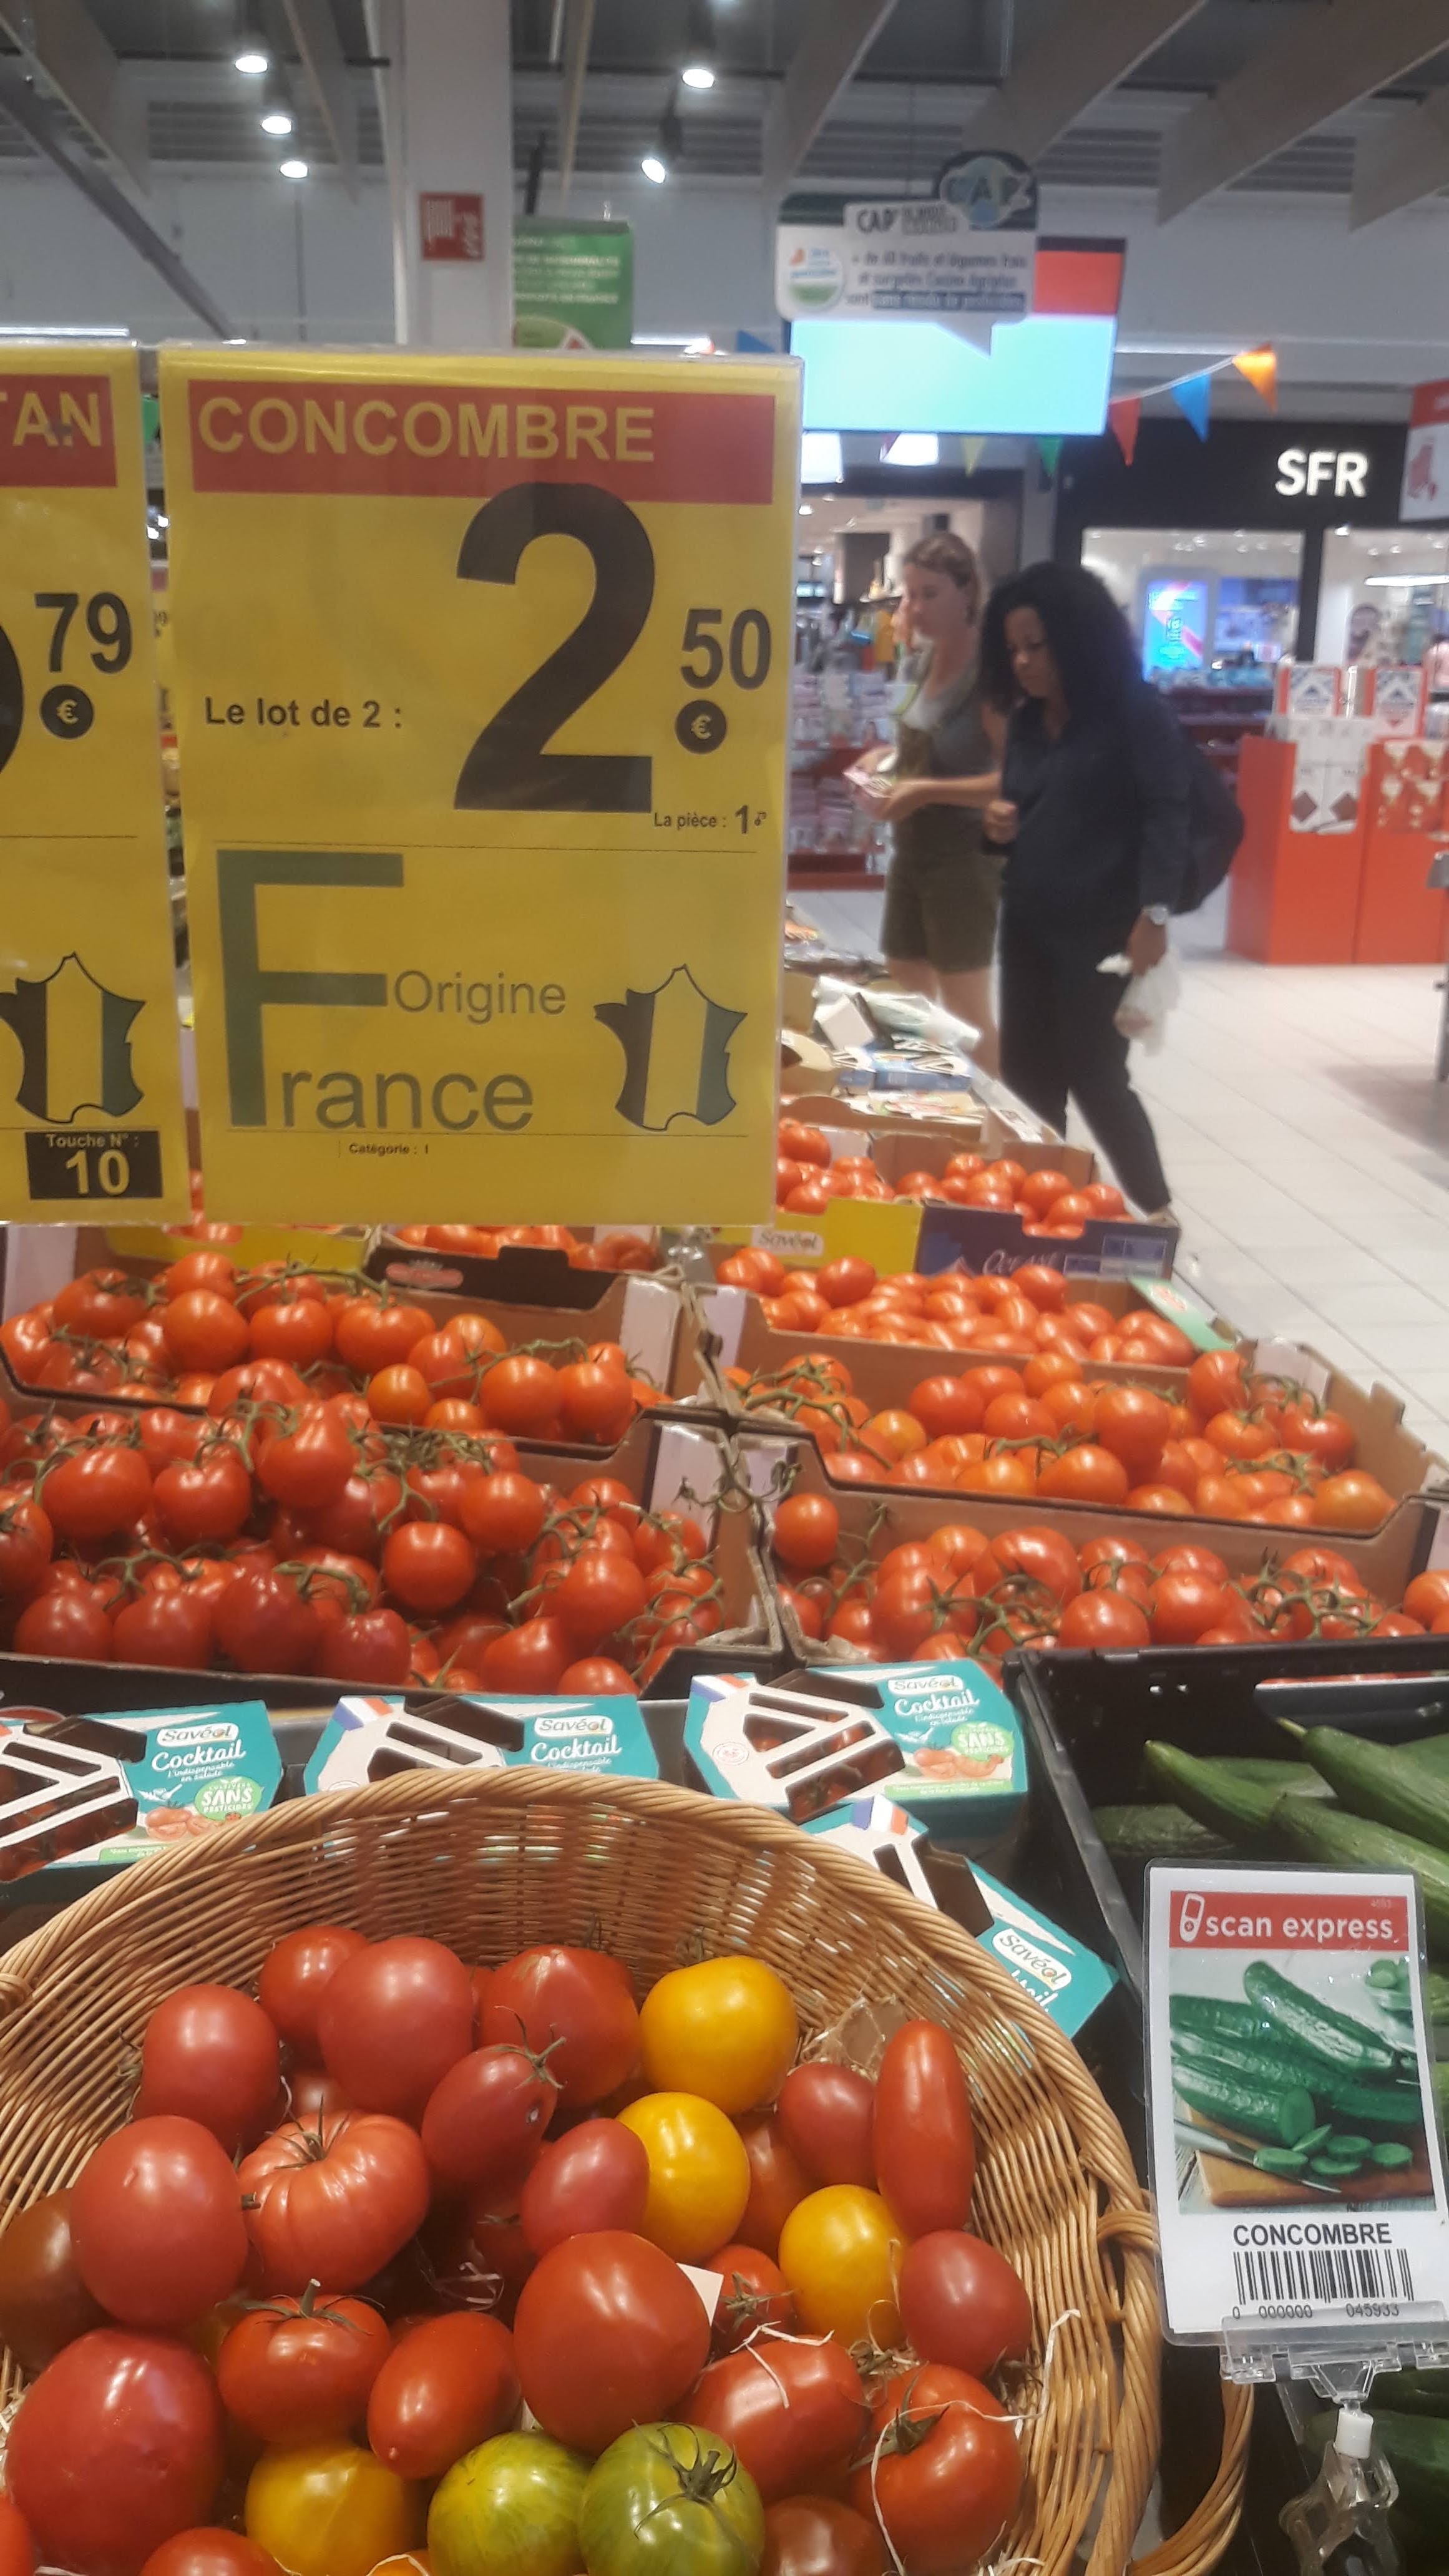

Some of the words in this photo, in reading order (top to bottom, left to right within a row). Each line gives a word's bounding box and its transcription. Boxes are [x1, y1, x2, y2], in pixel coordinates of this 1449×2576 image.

[0, 391, 102, 447] AN
[198, 397, 655, 462] CONCOMBRE
[1275, 448, 1369, 498] SFR
[35, 592, 132, 673] 79
[454, 482, 654, 812] 2
[681, 609, 771, 690] 50
[205, 696, 245, 725] Le
[258, 698, 300, 726] lot
[311, 699, 351, 728] de
[654, 812, 671, 827] La
[677, 812, 717, 831] pièce
[394, 970, 566, 1025] Origine
[46, 1133, 106, 1148] Touche
[66, 1149, 130, 1196] 10
[894, 1677, 959, 1691] Savéol
[894, 1689, 980, 1715] Cocktail
[162, 1724, 232, 1742] Savéol
[539, 1718, 607, 1731] Savéol
[531, 1734, 623, 1762] Cocktail
[957, 1731, 1005, 1749] SANS
[151, 1739, 246, 1772] Cocktail
[202, 1787, 253, 1807] SANS
[1206, 1916, 1271, 1937] scan
[1283, 1918, 1393, 1943] express
[999, 1934, 1067, 1984] Savéol
[1233, 2223, 1392, 2247] CONCOMBRE
[1232, 2306, 1241, 2320] 0
[1258, 2305, 1313, 2319] 000000
[1345, 2303, 1400, 2318] 045933
